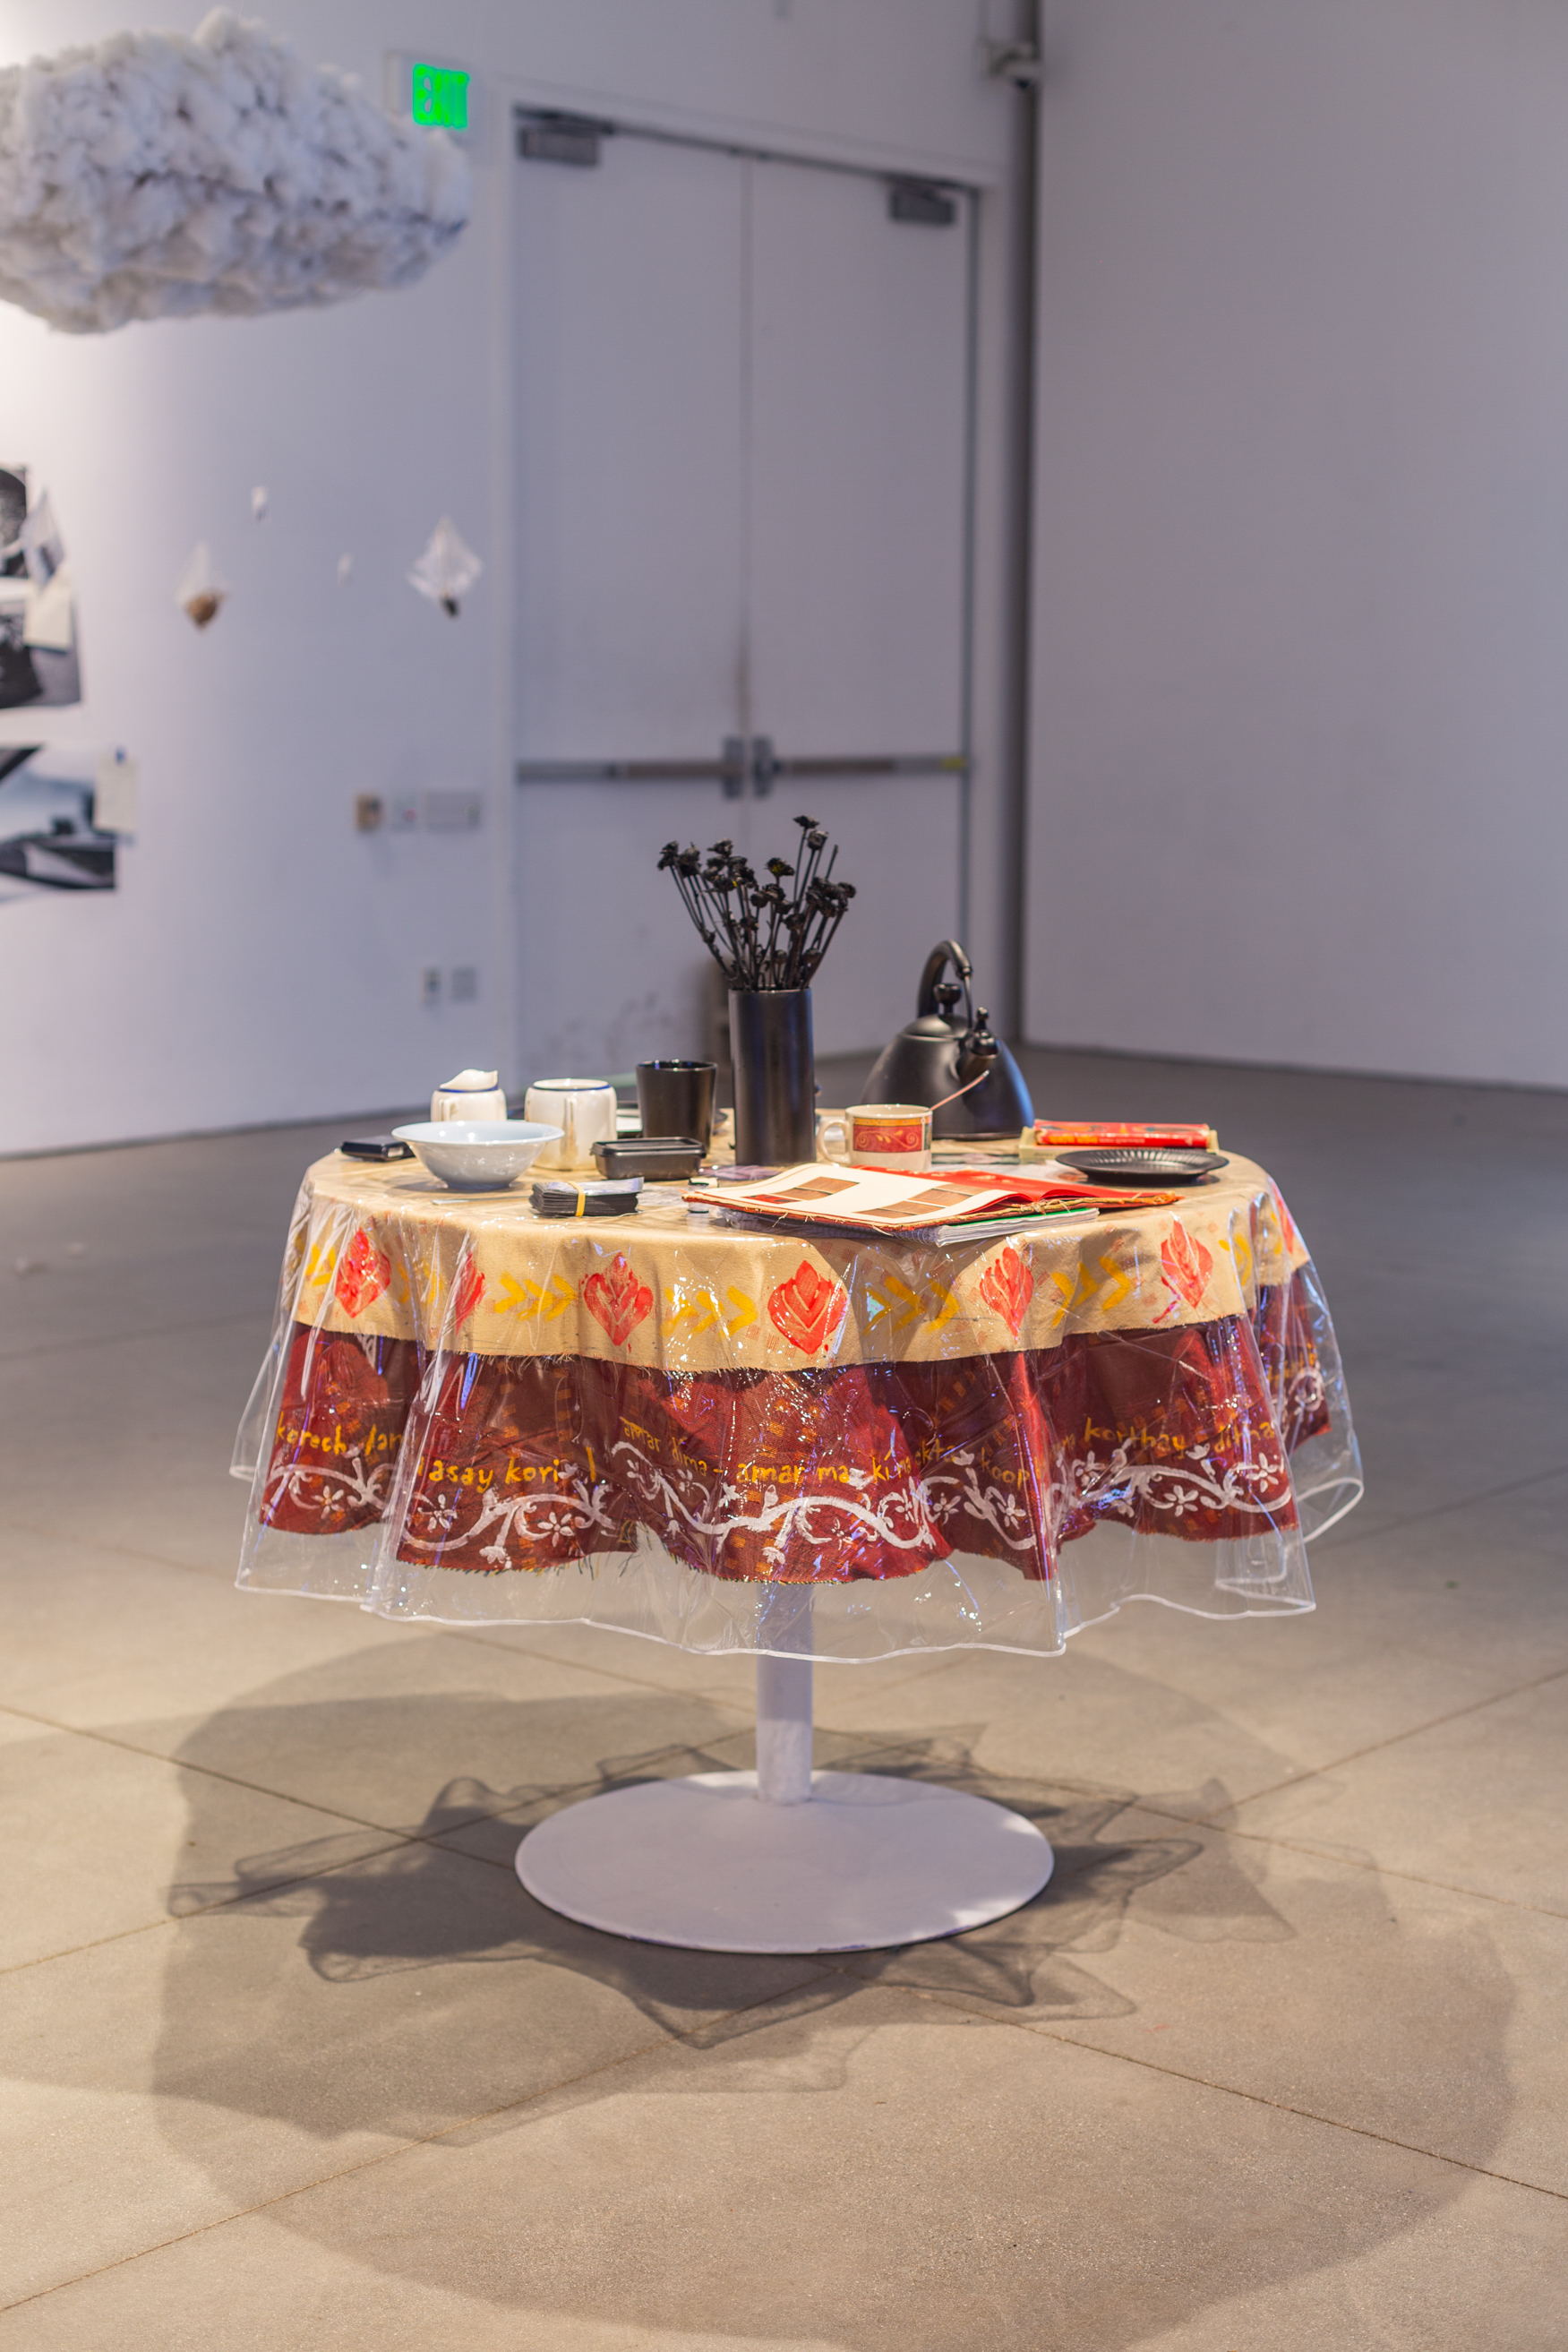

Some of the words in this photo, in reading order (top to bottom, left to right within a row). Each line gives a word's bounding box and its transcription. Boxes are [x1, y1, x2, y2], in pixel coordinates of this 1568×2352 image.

[413, 63, 469, 128] EXIT
[505, 1456, 559, 1484] kori
[736, 1463, 807, 1485] amar
